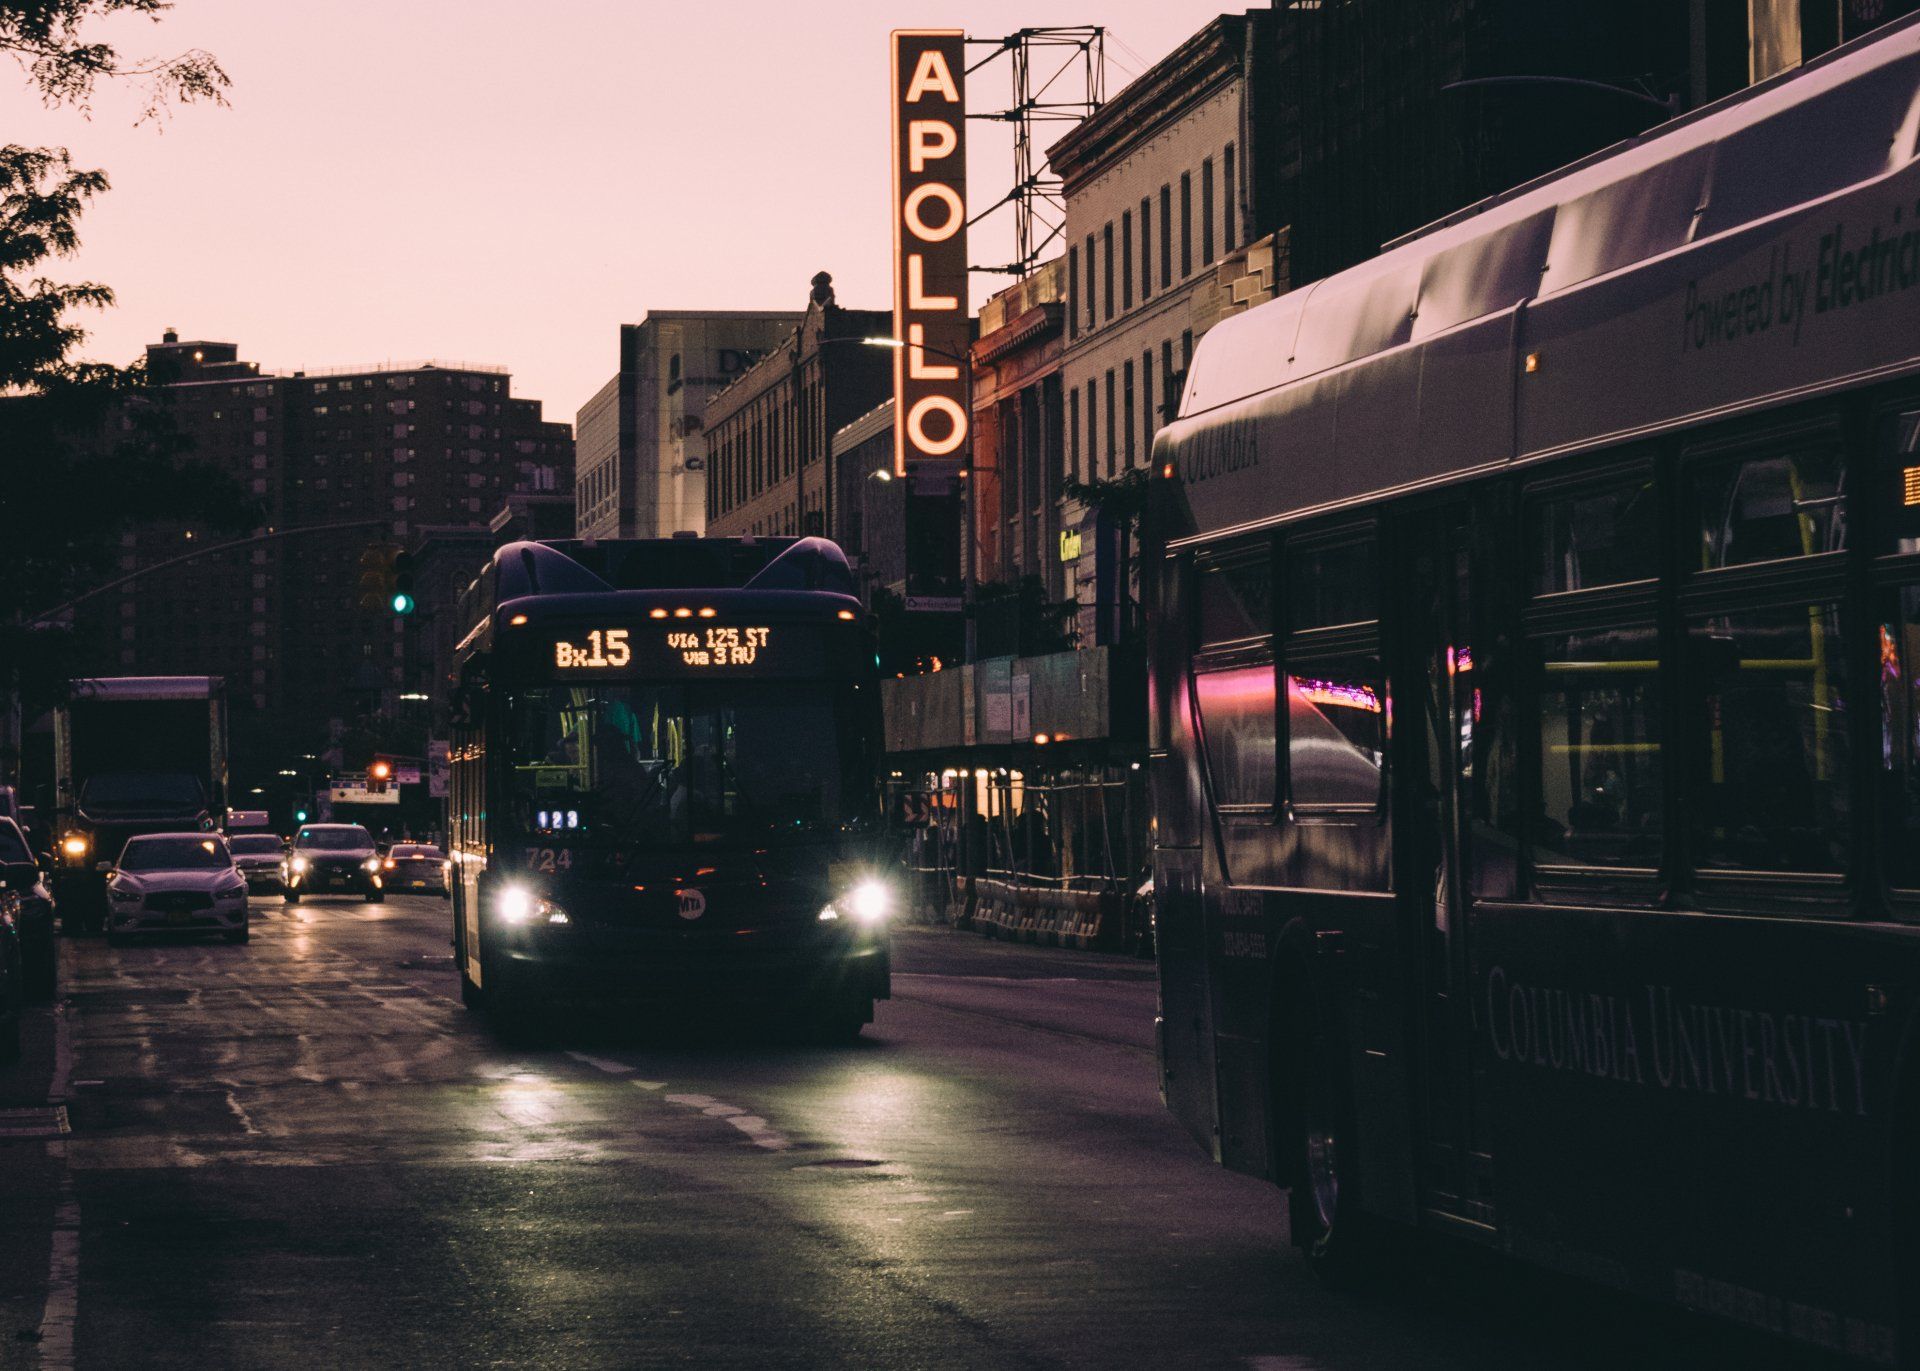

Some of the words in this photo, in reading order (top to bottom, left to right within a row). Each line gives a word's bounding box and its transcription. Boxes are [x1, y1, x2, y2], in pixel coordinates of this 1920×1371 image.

[904, 50, 968, 455] APOLLO
[1684, 244, 1778, 352] Powered
[1780, 241, 1811, 347] by
[1177, 418, 1258, 485] COLUMBIA
[555, 629, 631, 667] Bx15
[668, 633, 698, 648] VIA
[705, 628, 739, 648] 125
[745, 628, 770, 647] ST
[714, 647, 726, 665] 3
[731, 647, 755, 665] AV
[526, 847, 572, 874] 724
[1645, 985, 1868, 1115] UNIVERSITY
